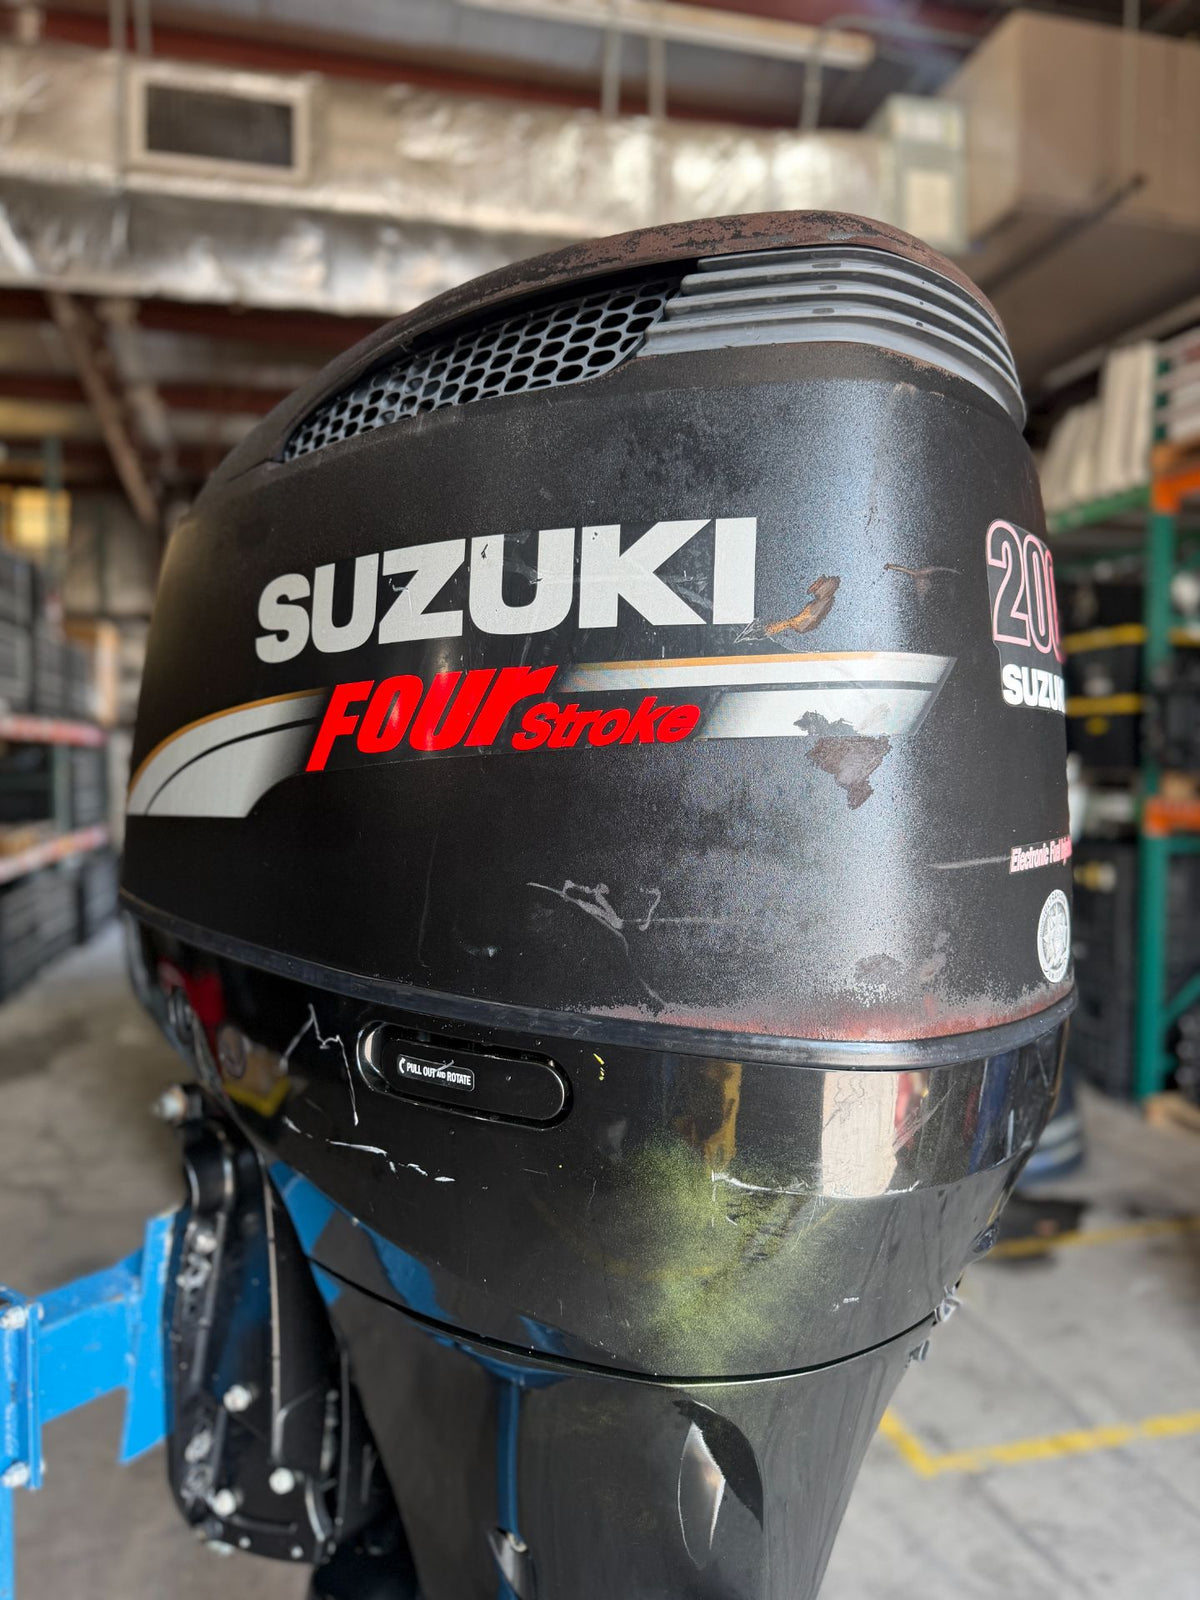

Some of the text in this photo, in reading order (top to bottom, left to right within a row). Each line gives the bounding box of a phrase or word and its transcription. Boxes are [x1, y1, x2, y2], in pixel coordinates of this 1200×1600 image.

[254, 516, 757, 664] SUZUKI
[511, 696, 701, 752] Stroke
[1010, 842, 1049, 873] Electronic
[406, 1062, 422, 1075] PULL
[423, 1066, 437, 1078] OUT
[446, 1071, 471, 1086] ROTATE
